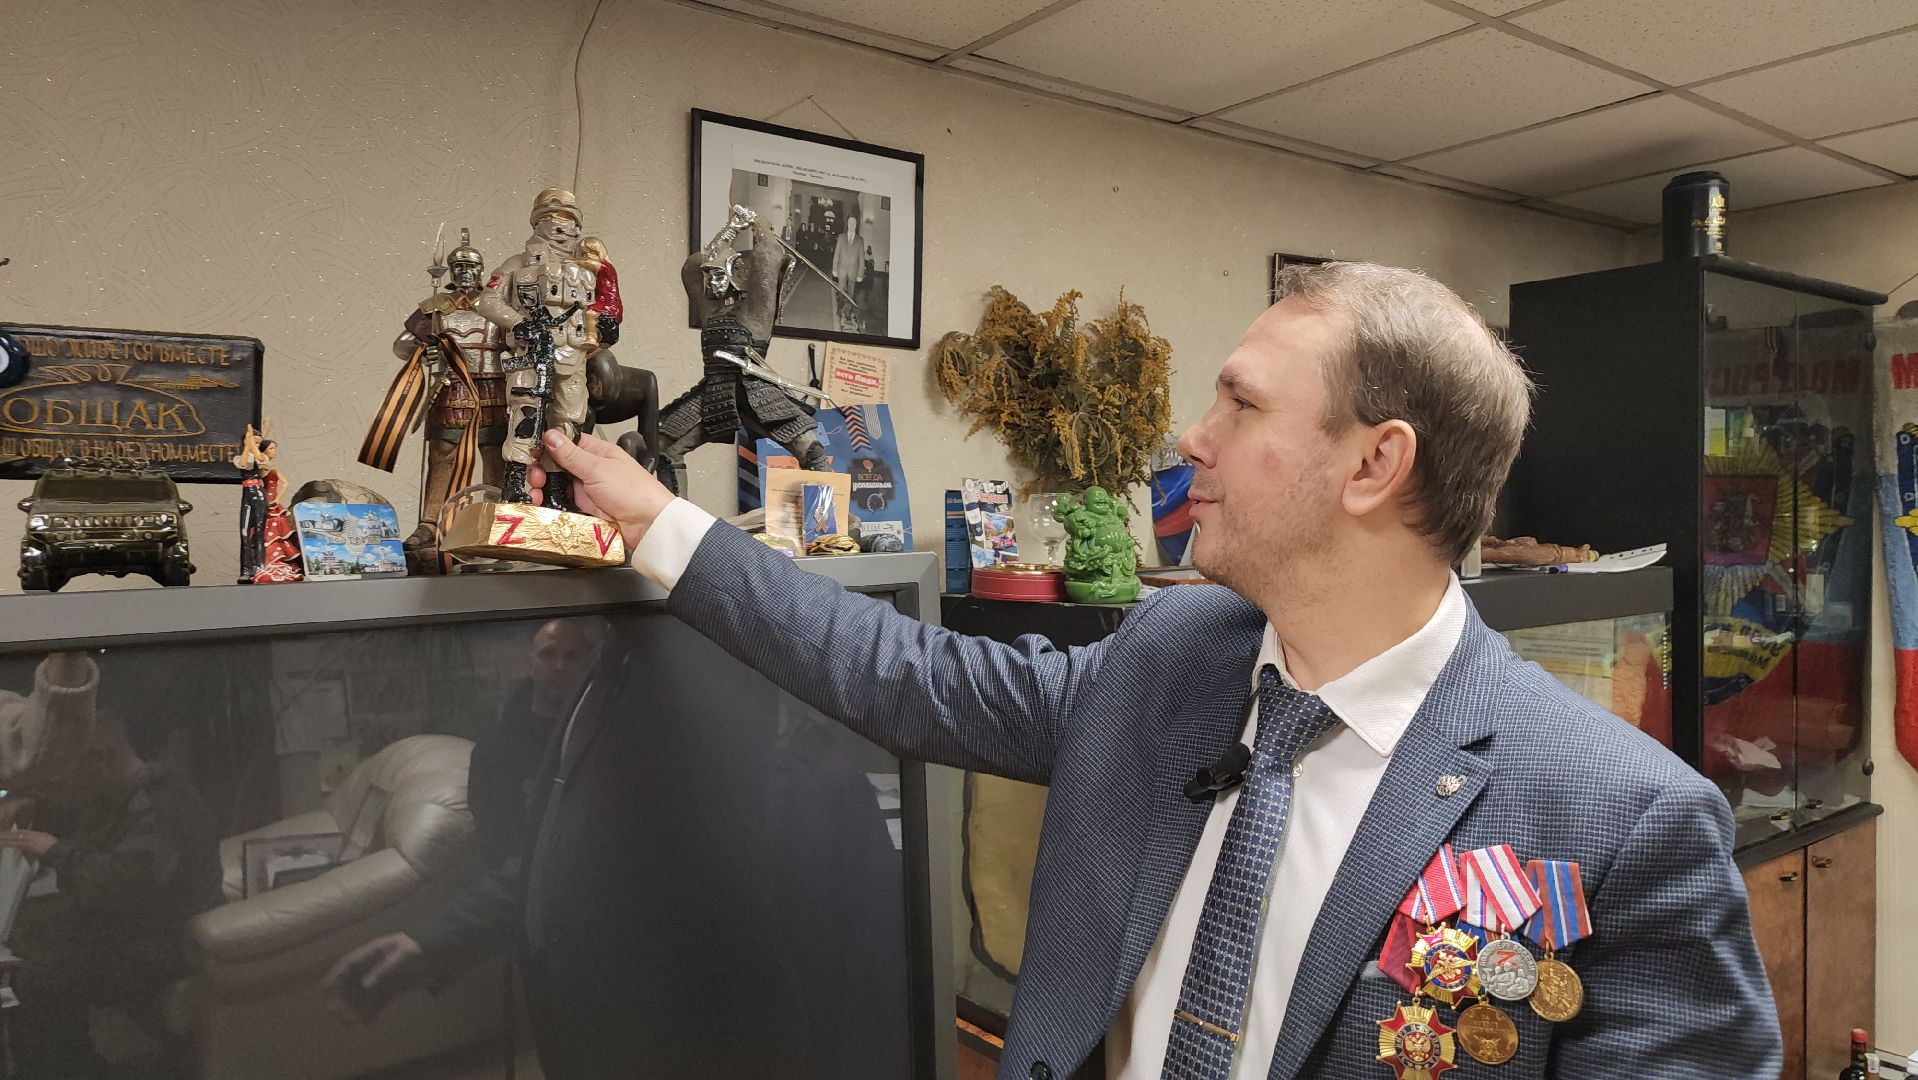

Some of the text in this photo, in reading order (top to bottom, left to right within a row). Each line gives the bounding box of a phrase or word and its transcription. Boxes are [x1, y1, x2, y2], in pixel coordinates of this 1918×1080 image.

[160, 344, 230, 366] ВМЕСТЕ
[2, 397, 188, 433] ОБЩАК
[495, 514, 619, 558] Z V
